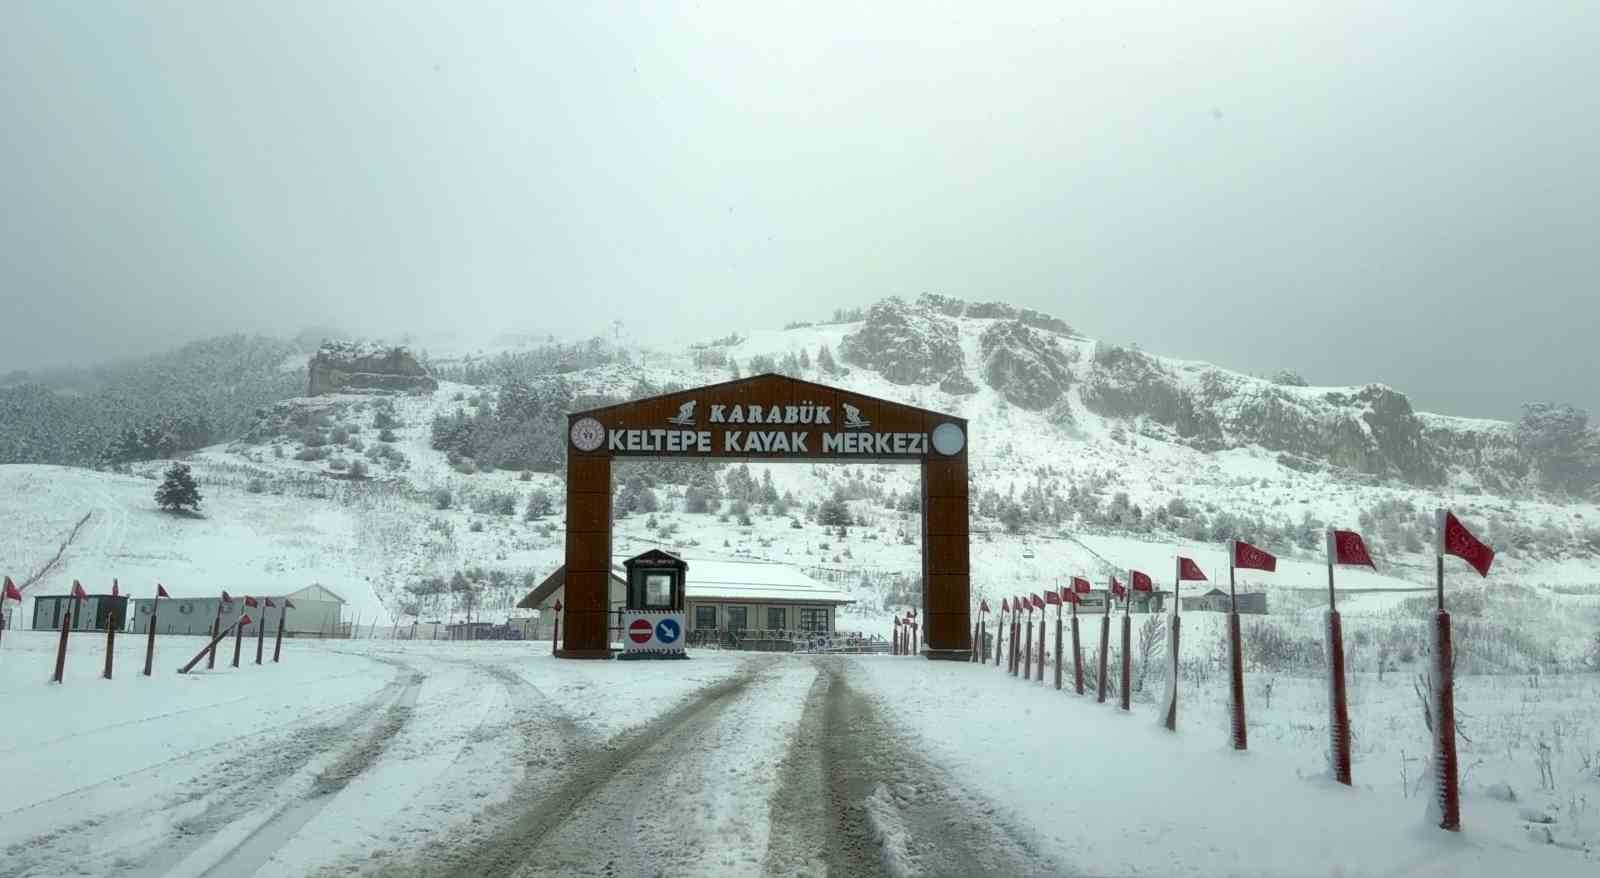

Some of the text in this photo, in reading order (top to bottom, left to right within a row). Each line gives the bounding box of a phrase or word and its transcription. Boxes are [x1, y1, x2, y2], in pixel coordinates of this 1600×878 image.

[709, 400, 832, 424] KARABÜK
[608, 429, 712, 452] KELTEPE
[725, 432, 808, 453] KAYAK
